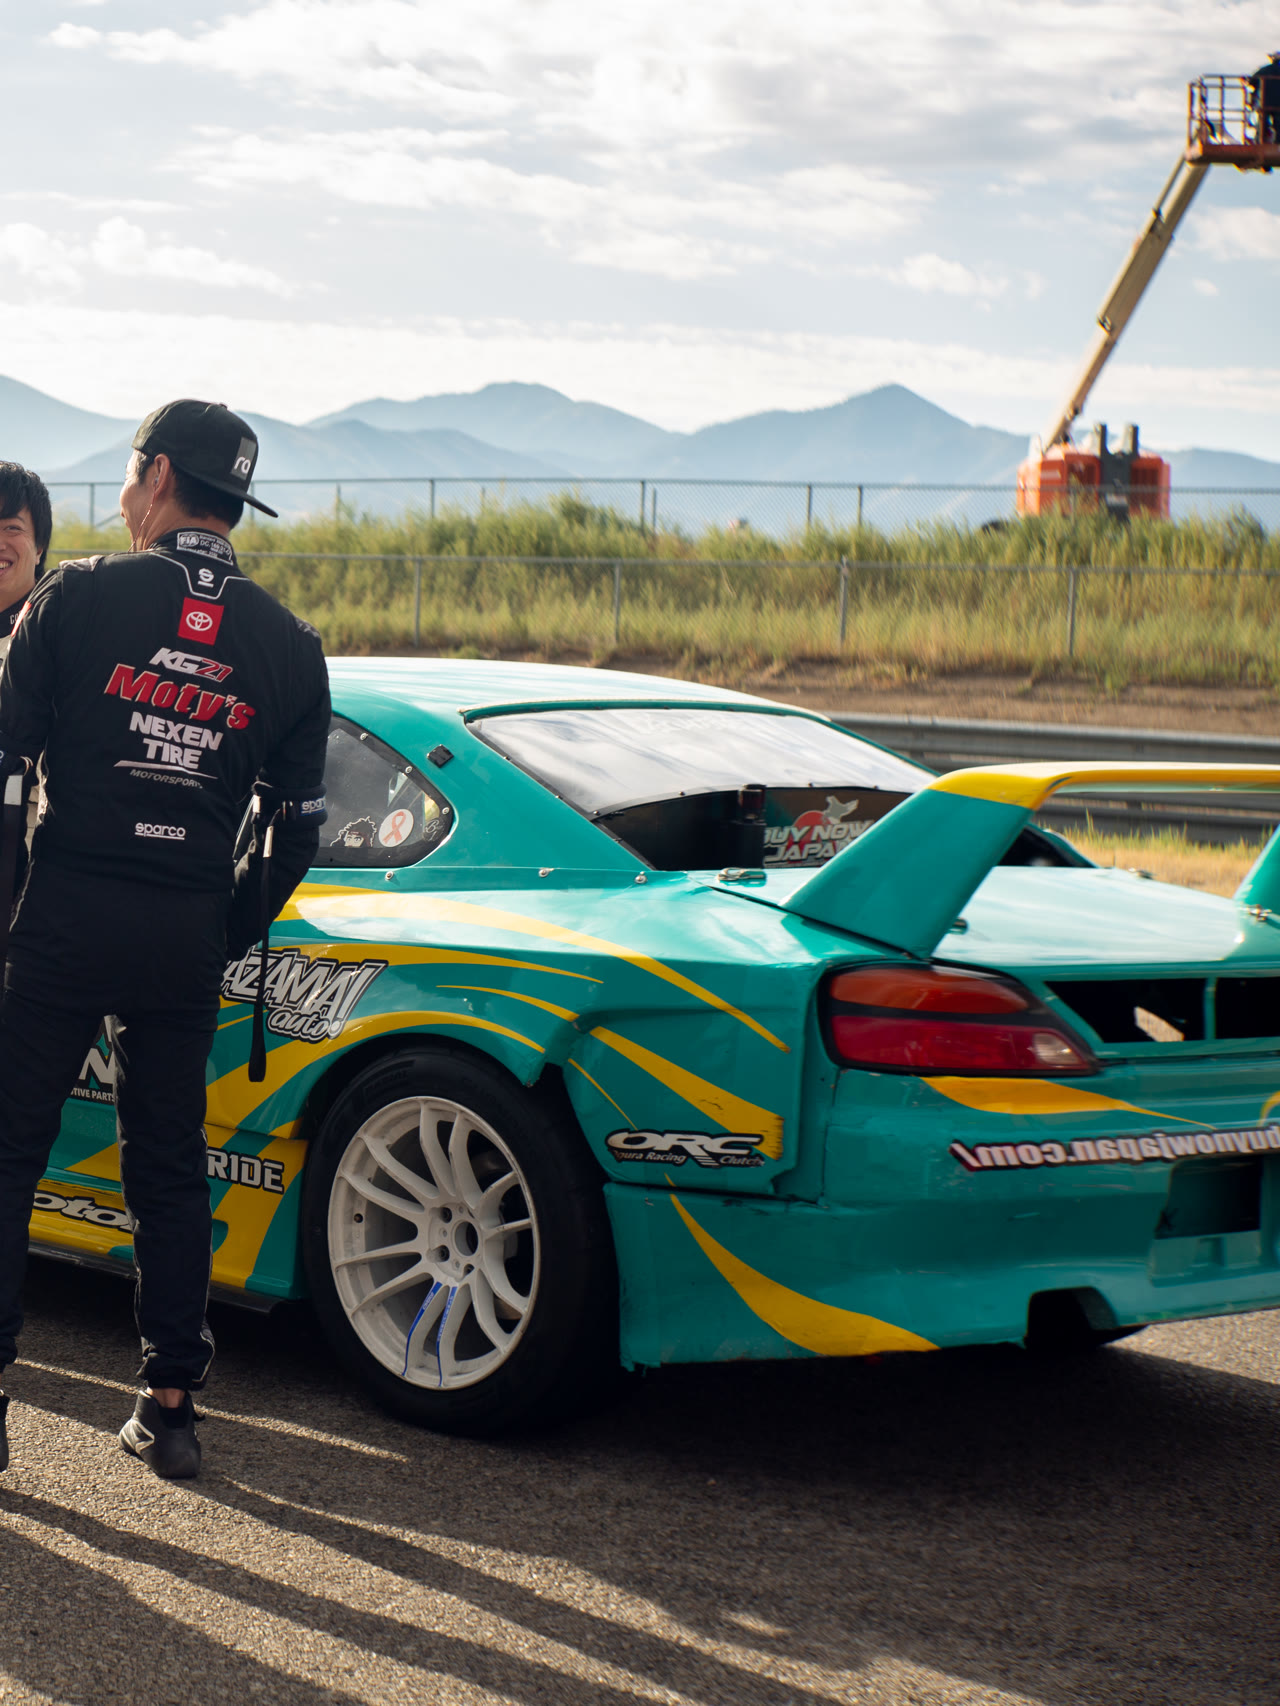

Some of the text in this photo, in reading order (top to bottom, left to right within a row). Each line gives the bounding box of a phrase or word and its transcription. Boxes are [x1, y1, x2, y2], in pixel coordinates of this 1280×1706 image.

[149, 647, 234, 683] KG21
[104, 663, 256, 730] Moty's
[129, 711, 224, 751] NEXEN
[143, 737, 202, 769] TIRE
[134, 822, 186, 838] sparco
[607, 1131, 762, 1166] ORC
[645, 1151, 687, 1165] Racing
[719, 1154, 766, 1167] Clutch
